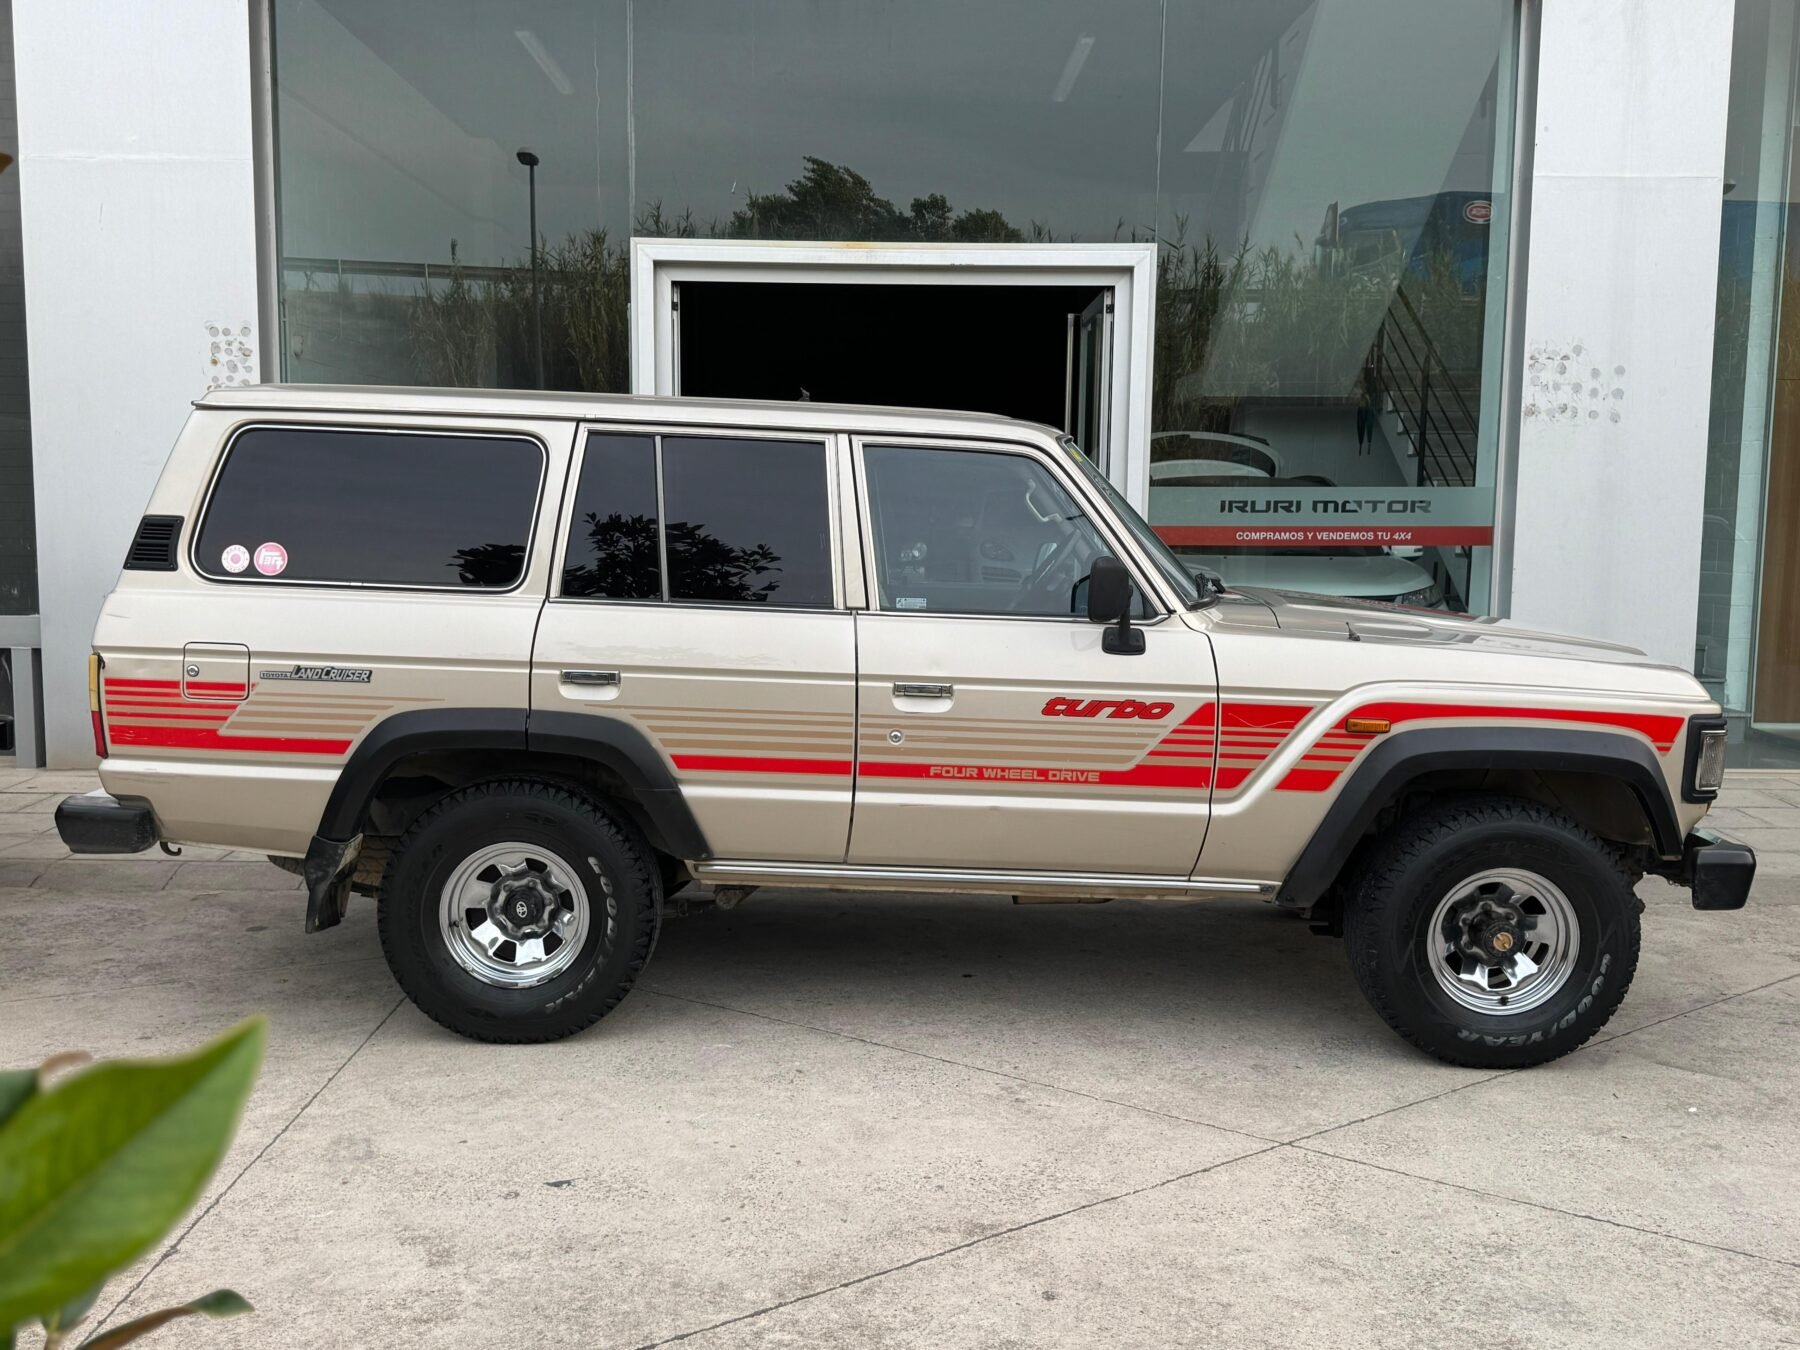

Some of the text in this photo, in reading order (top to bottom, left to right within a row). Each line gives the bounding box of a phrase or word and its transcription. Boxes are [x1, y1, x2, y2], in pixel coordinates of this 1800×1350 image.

[1220, 500, 1432, 513] IRURI MOTOR
[1236, 531, 1412, 541] COMPRAMOS Y VENDEMOS TU 4X4
[262, 671, 289, 679] TOYOTA
[1041, 696, 1175, 720] turbo
[929, 766, 1100, 782] FOUR WHEEL DRIVE
